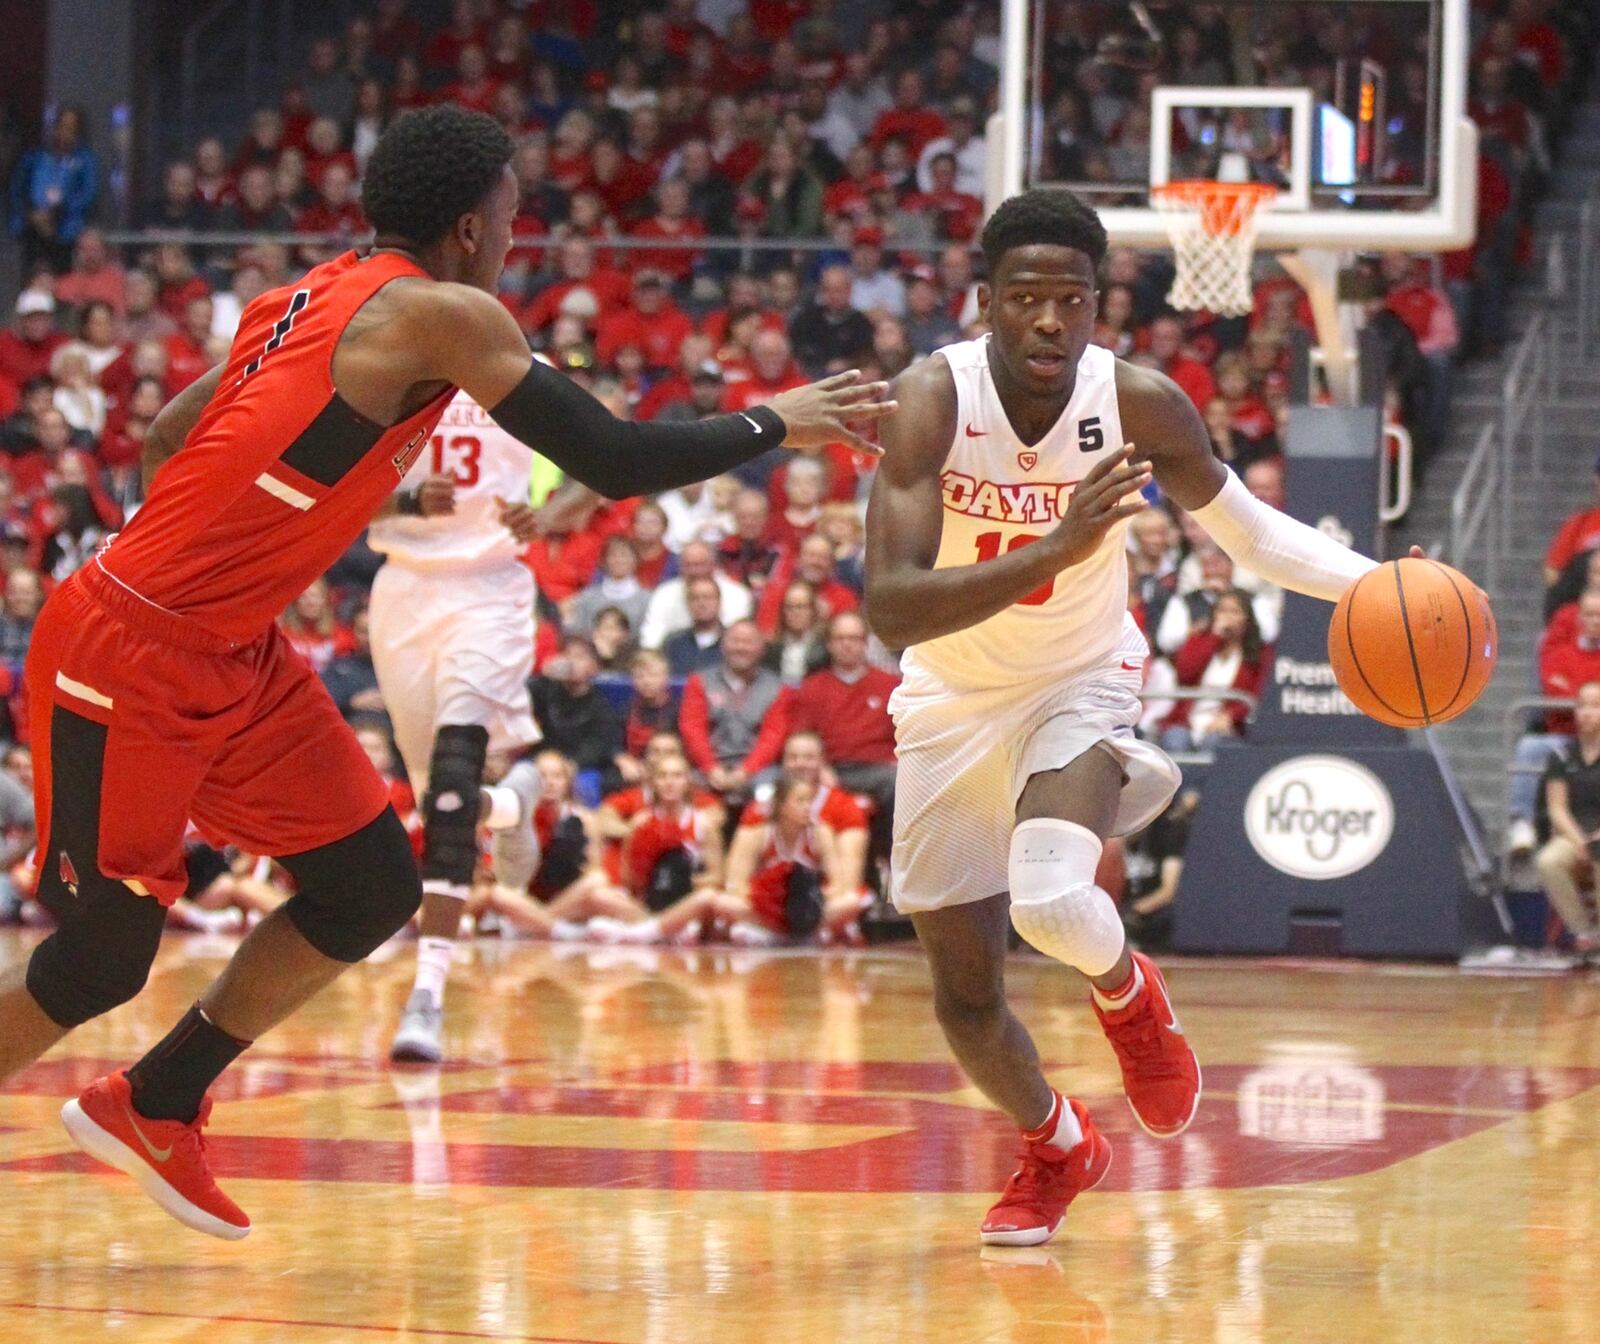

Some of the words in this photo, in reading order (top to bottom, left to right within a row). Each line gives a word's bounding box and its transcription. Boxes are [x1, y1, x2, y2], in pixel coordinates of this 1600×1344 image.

[1078, 417, 1104, 452] 5
[431, 435, 481, 487] 13
[1264, 779, 1376, 862] Kroger
